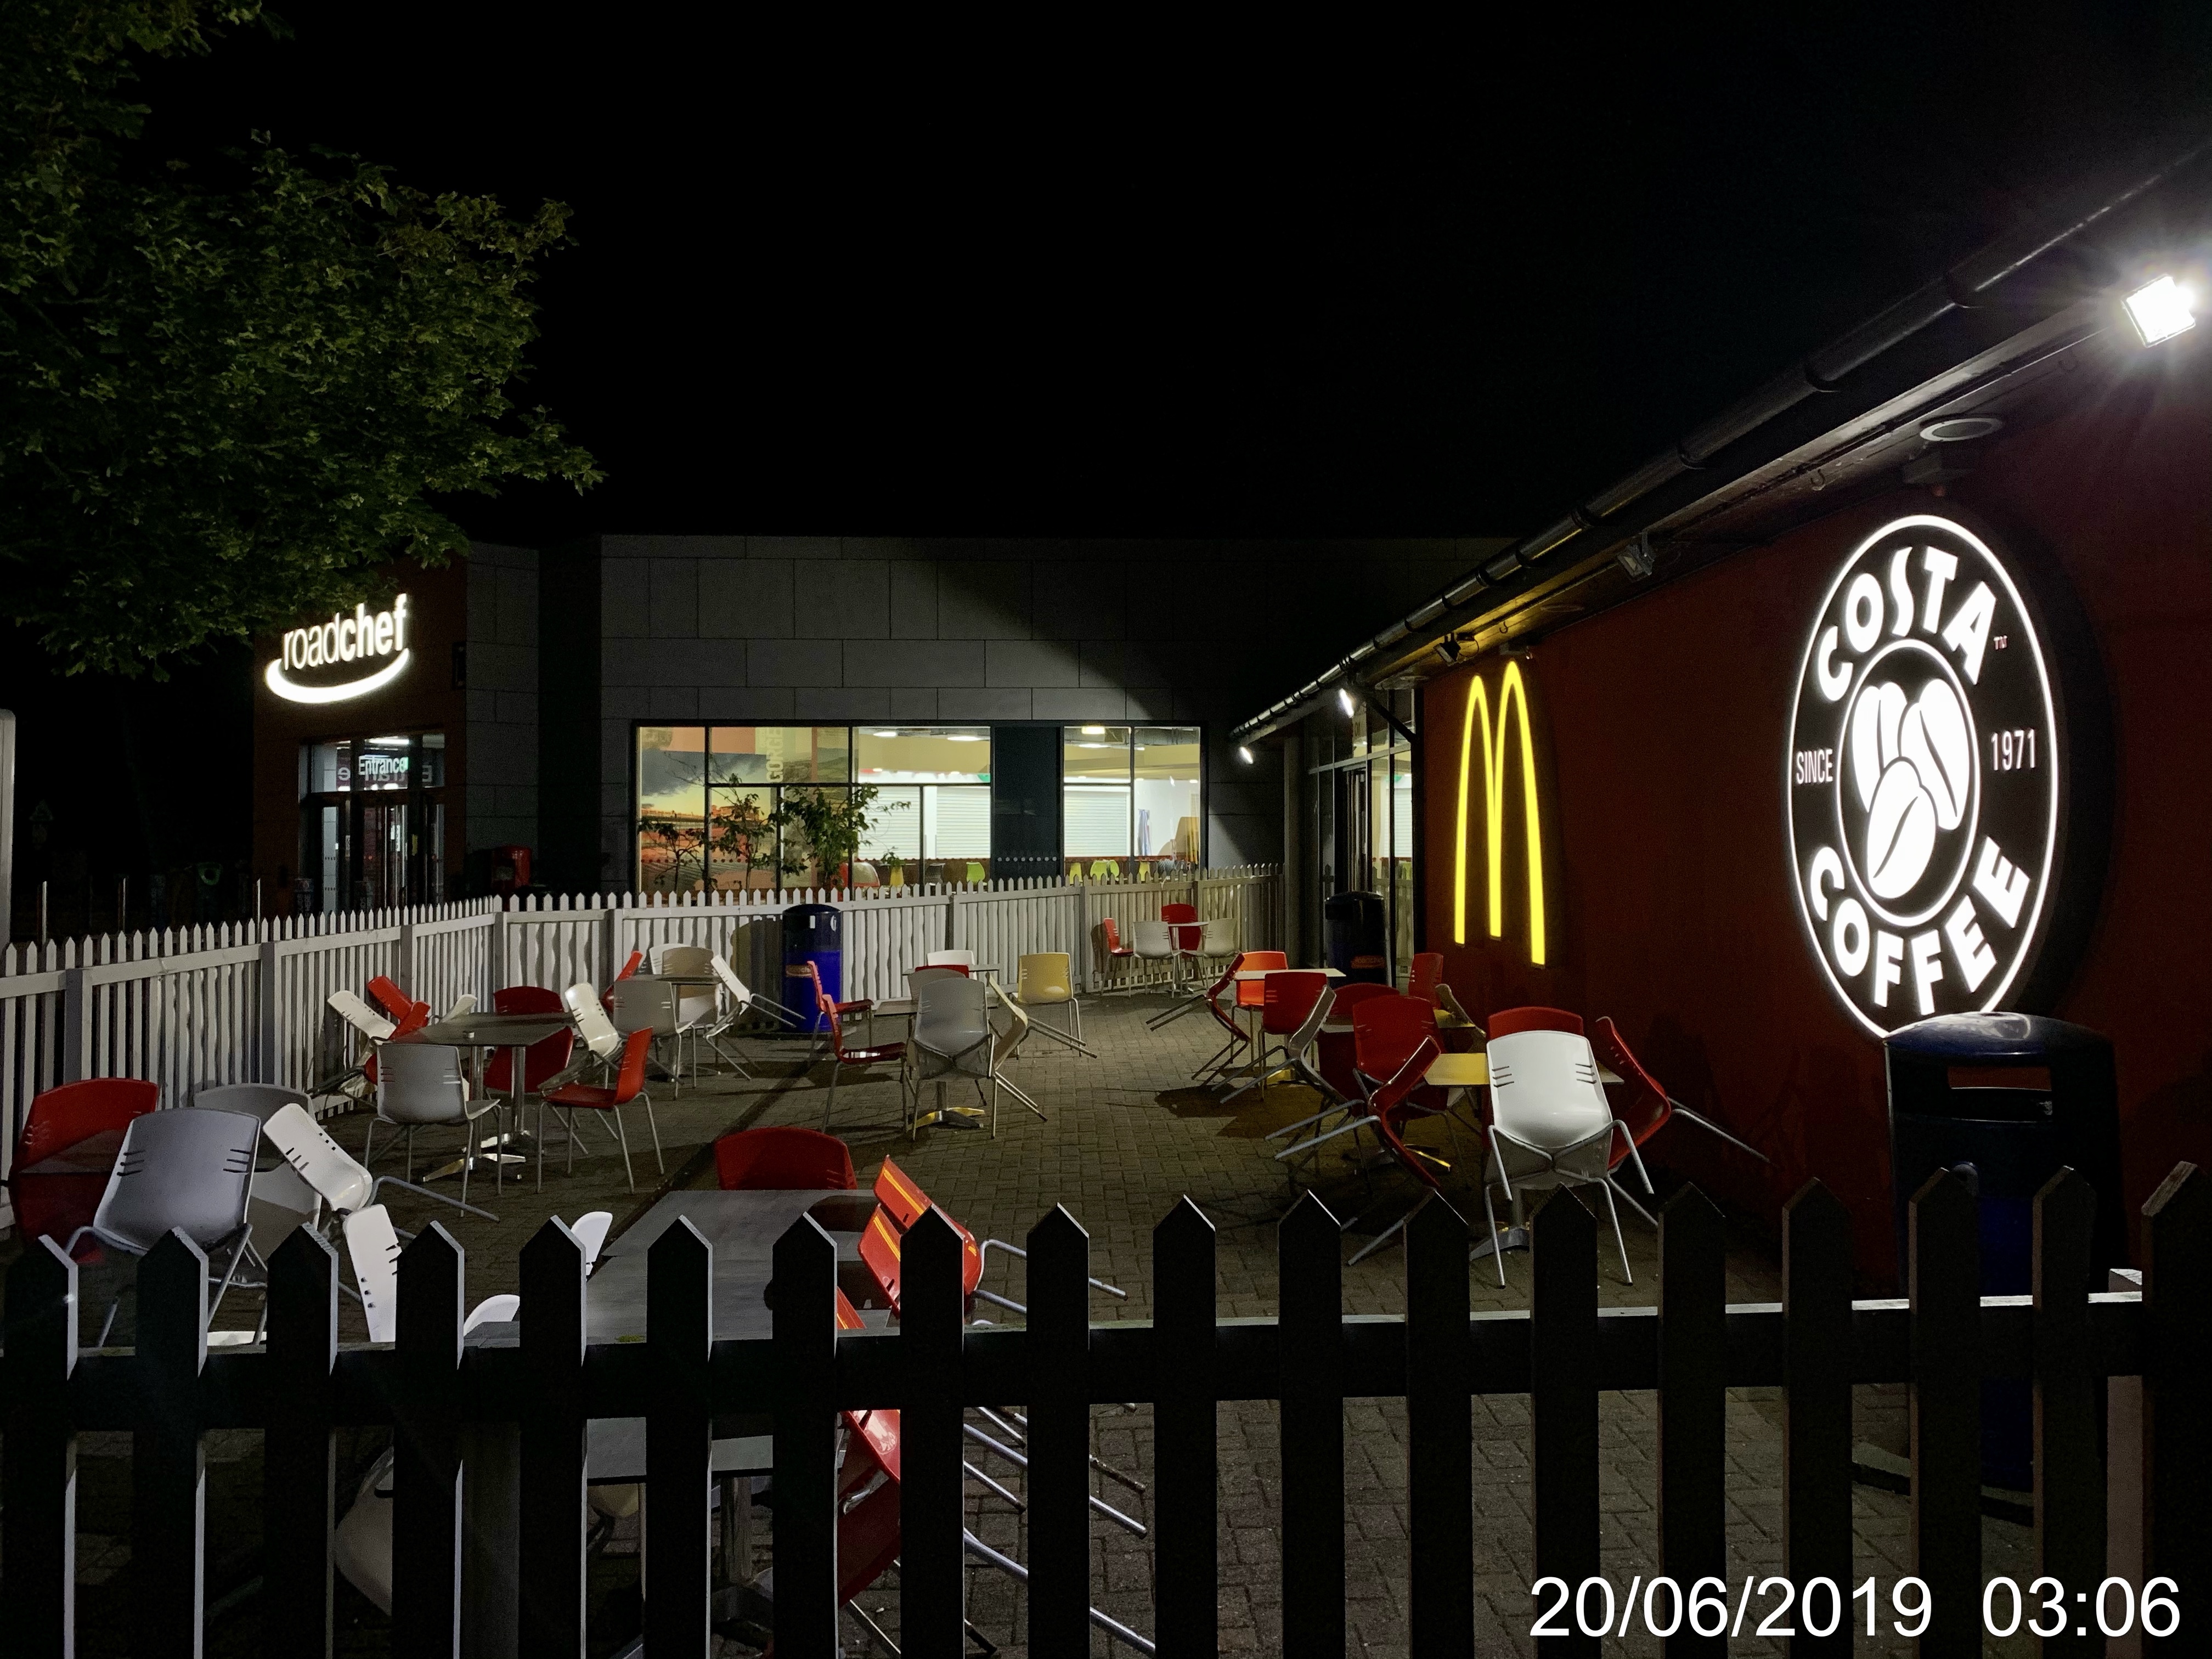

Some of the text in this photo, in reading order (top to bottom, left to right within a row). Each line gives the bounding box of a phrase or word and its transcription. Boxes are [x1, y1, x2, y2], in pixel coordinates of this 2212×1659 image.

[283, 592, 409, 671] roadchef
[1816, 545, 1997, 702] COSTA
[358, 755, 406, 775] Entrance
[766, 727, 783, 782] GORGE
[1796, 728, 2035, 785] SINCE 1971
[1809, 836, 2031, 1016] COFFEE
